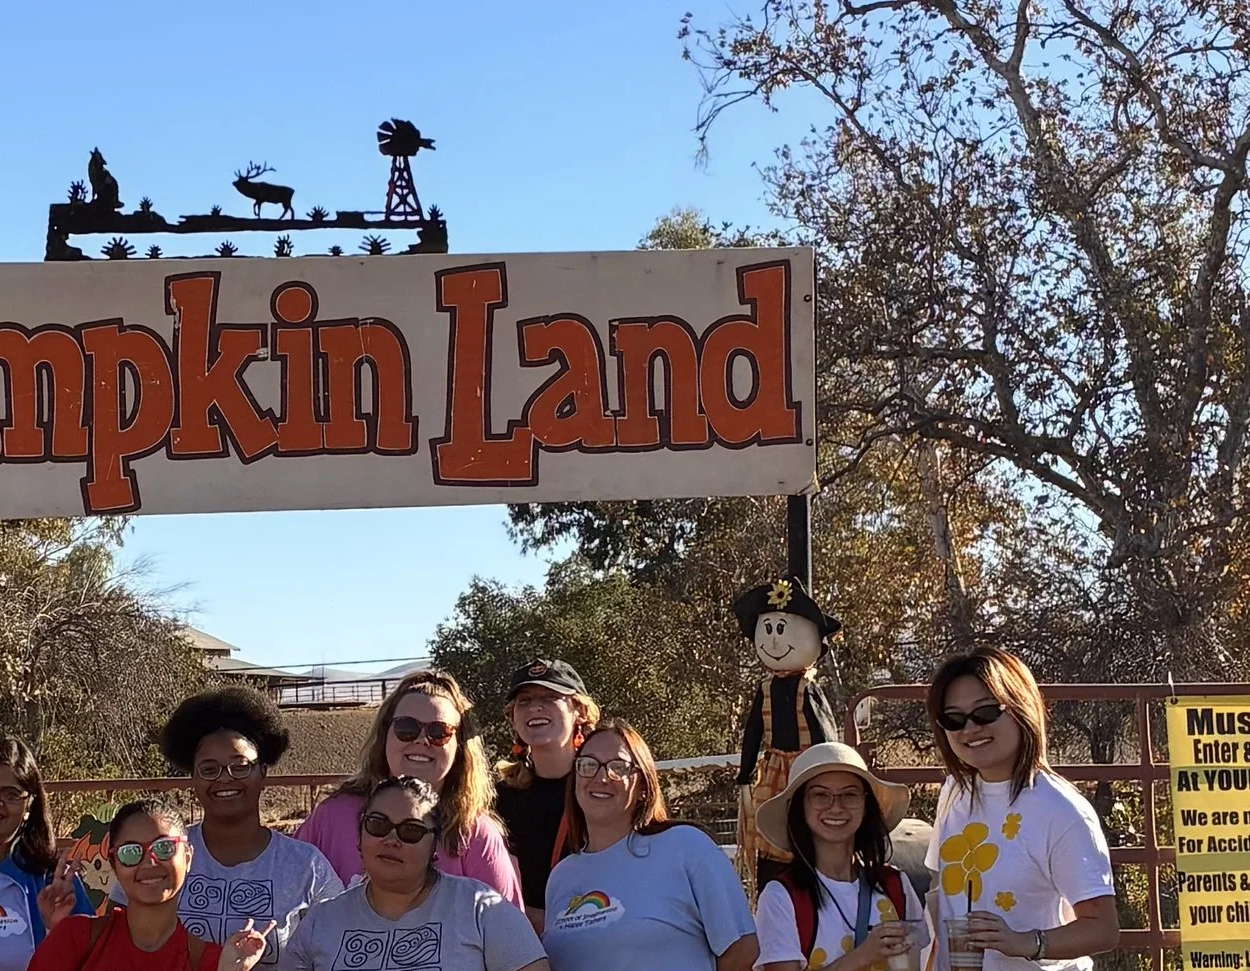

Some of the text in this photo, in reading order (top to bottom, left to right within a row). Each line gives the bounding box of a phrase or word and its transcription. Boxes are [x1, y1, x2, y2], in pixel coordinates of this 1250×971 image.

[433, 260, 802, 487] Land
[1193, 738, 1240, 764] Enter
[1177, 770, 1200, 792] At
[1181, 809, 1208, 826] We
[1211, 811, 1239, 825] are
[1178, 836, 1203, 853] For
[1178, 871, 1236, 892] Parents
[1189, 905, 1223, 925] your
[1190, 951, 1243, 969] Warning:
